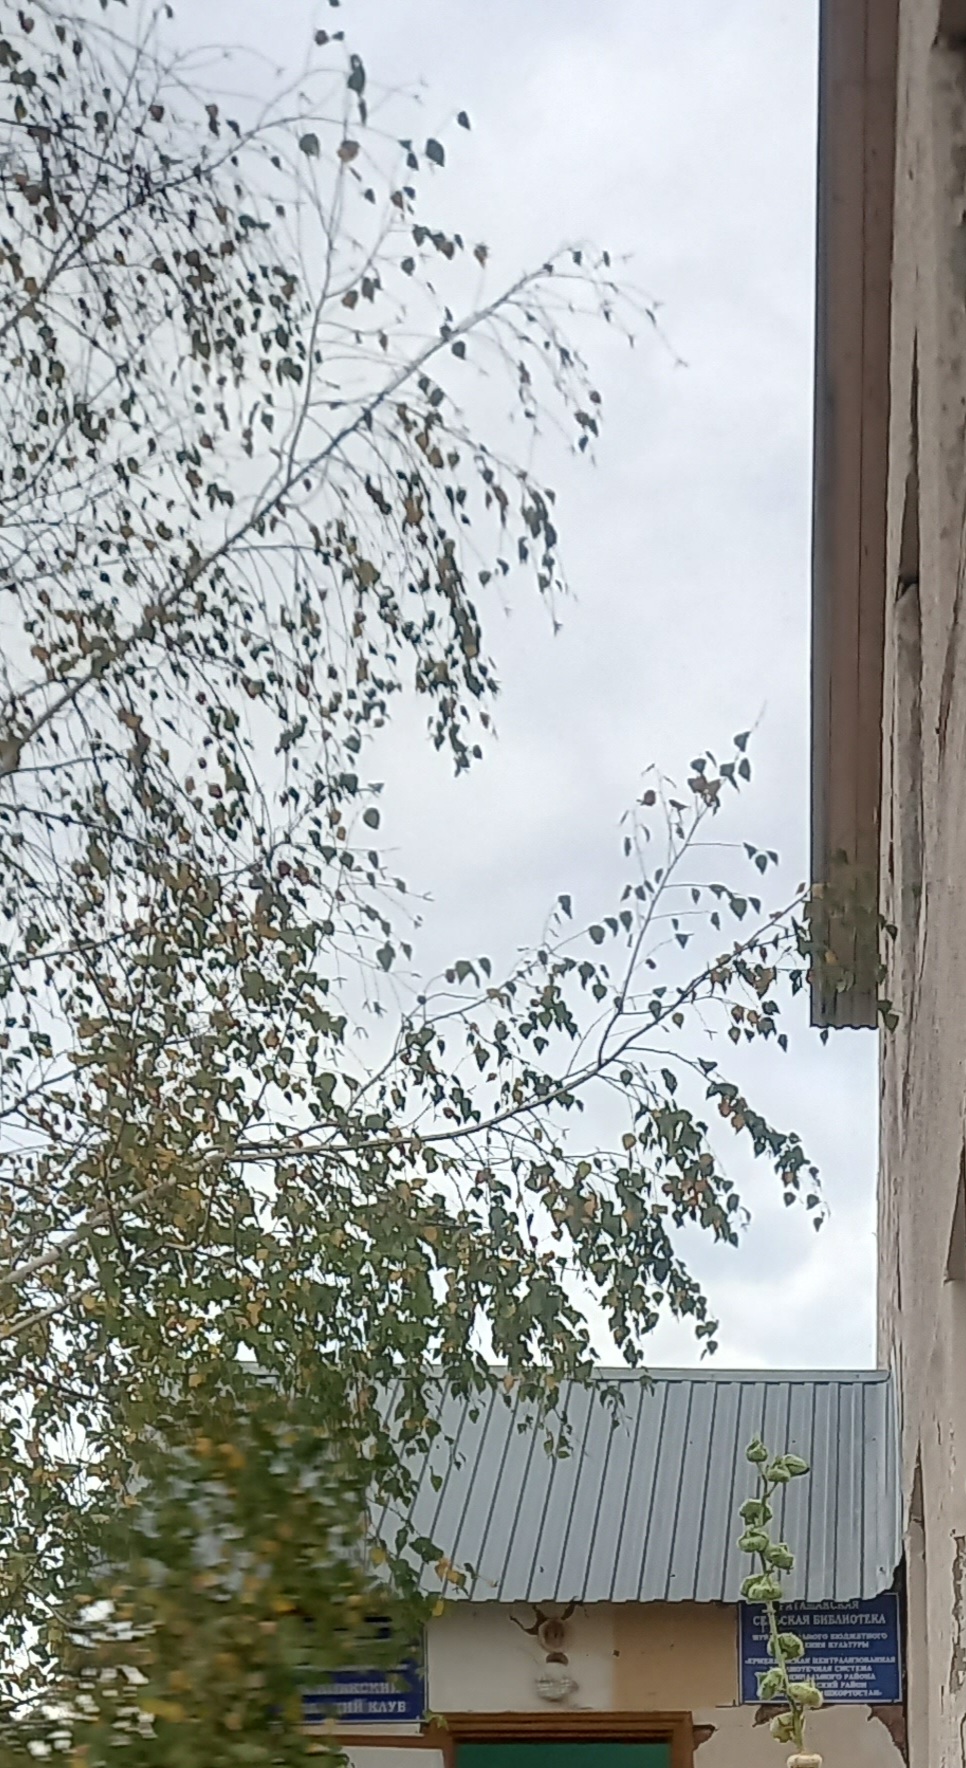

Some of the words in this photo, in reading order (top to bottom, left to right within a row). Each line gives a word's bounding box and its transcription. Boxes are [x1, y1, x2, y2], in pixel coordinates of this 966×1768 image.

[752, 1615, 810, 1627] СЕСКАЯ
[813, 1613, 886, 1626] БИБЛИОТЕКА
[368, 1701, 407, 1713] КЛУБ
